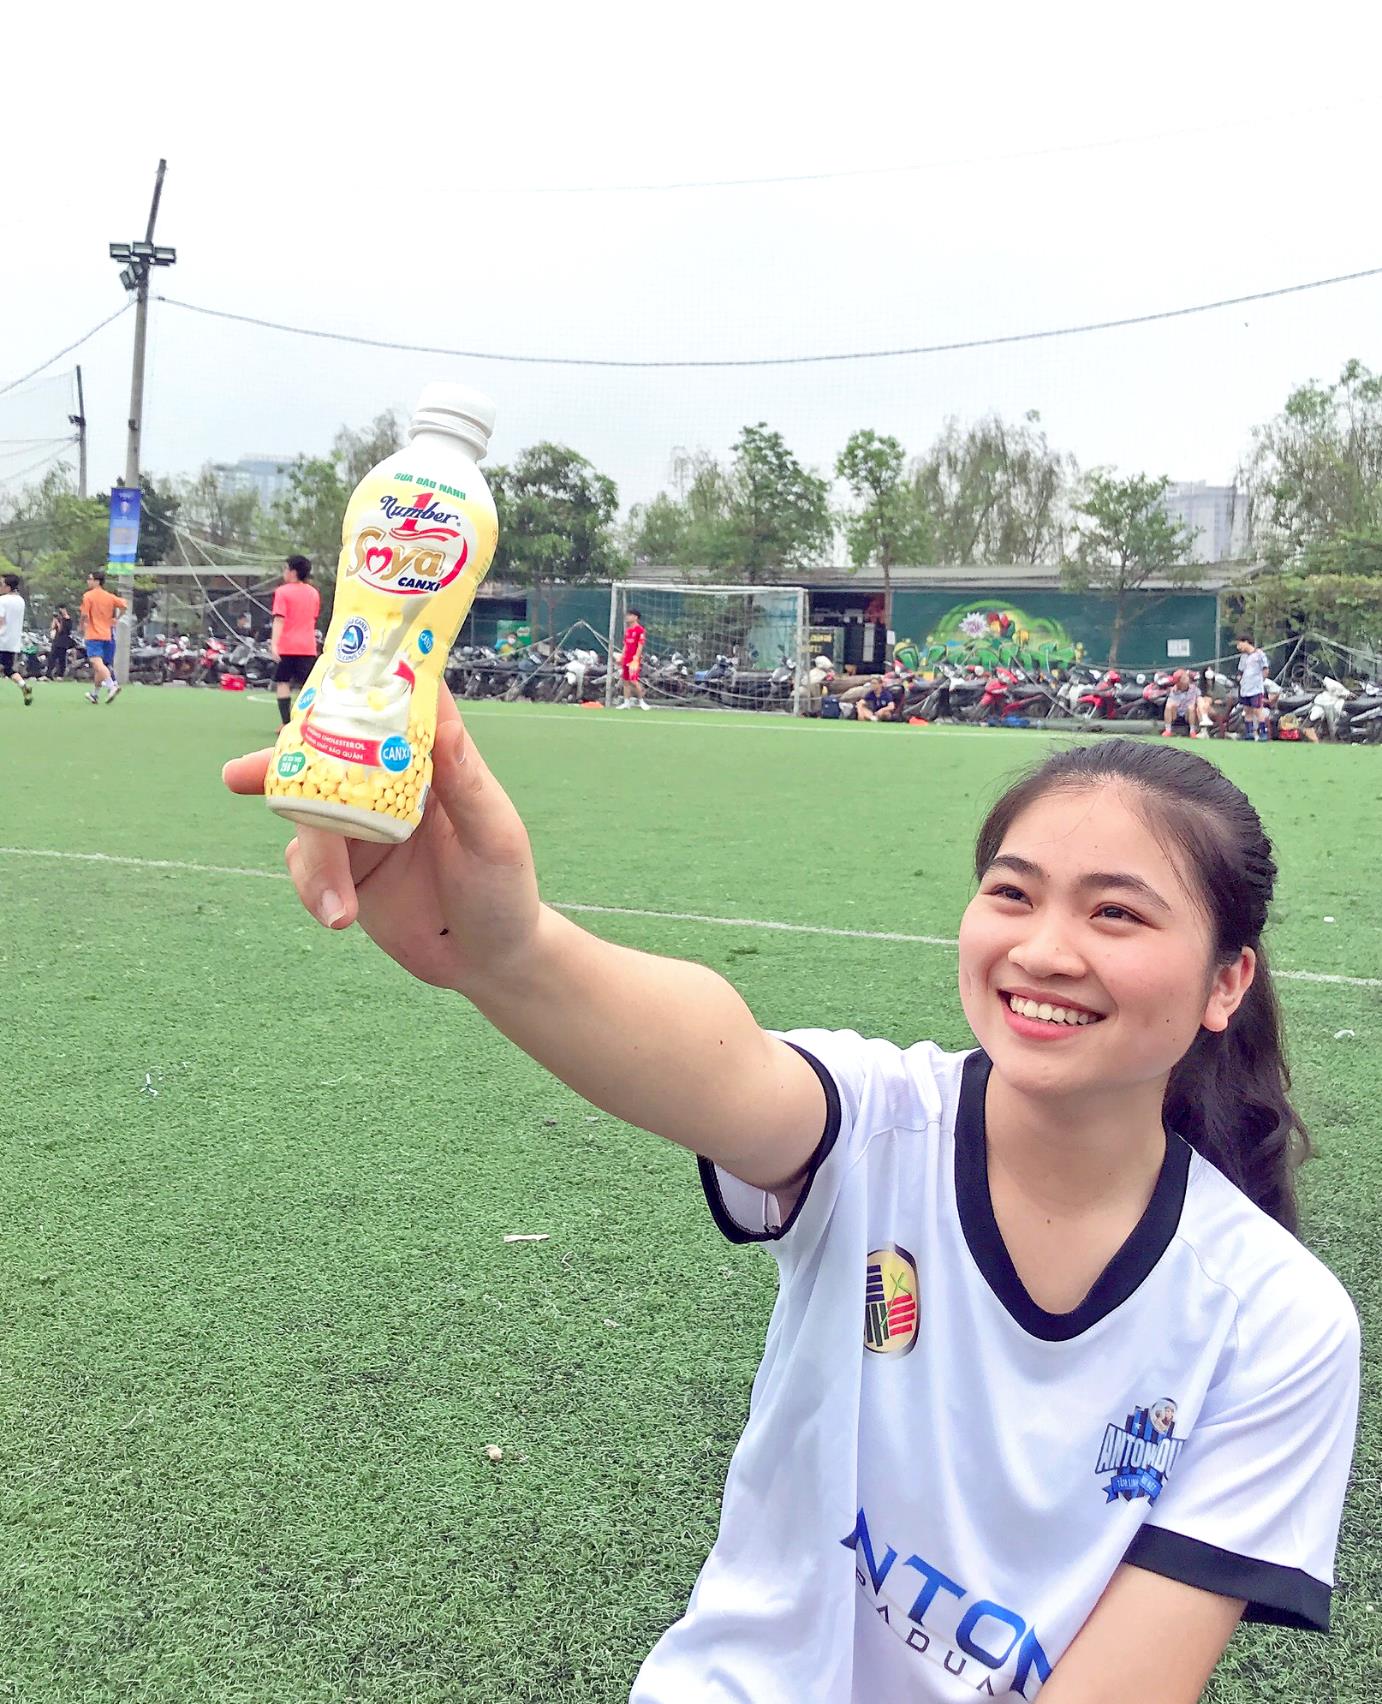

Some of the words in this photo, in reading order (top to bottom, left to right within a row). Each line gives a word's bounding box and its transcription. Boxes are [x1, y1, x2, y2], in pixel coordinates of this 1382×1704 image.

[380, 495, 458, 523] Number
[398, 577, 441, 592] CANXI
[382, 747, 410, 761] CANXI
